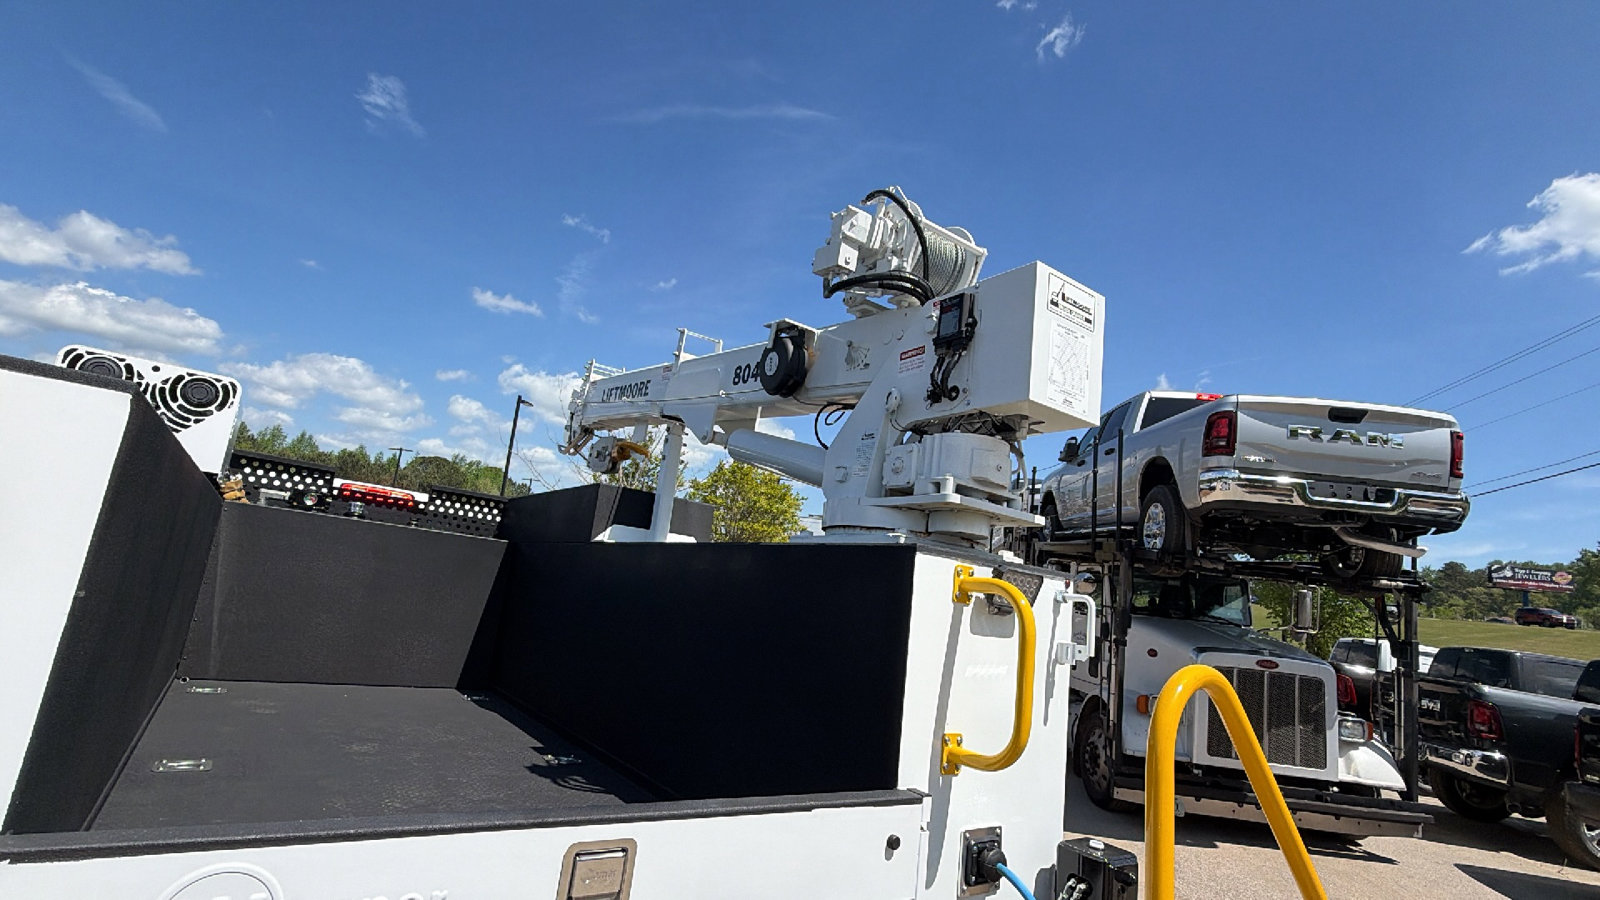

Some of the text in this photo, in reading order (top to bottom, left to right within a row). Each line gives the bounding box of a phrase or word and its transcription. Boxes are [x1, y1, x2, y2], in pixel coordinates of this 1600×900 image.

[601, 379, 651, 402] LIFTMOORE
[1287, 424, 1404, 449] RAM
[1515, 573, 1551, 581] JEWELERS
